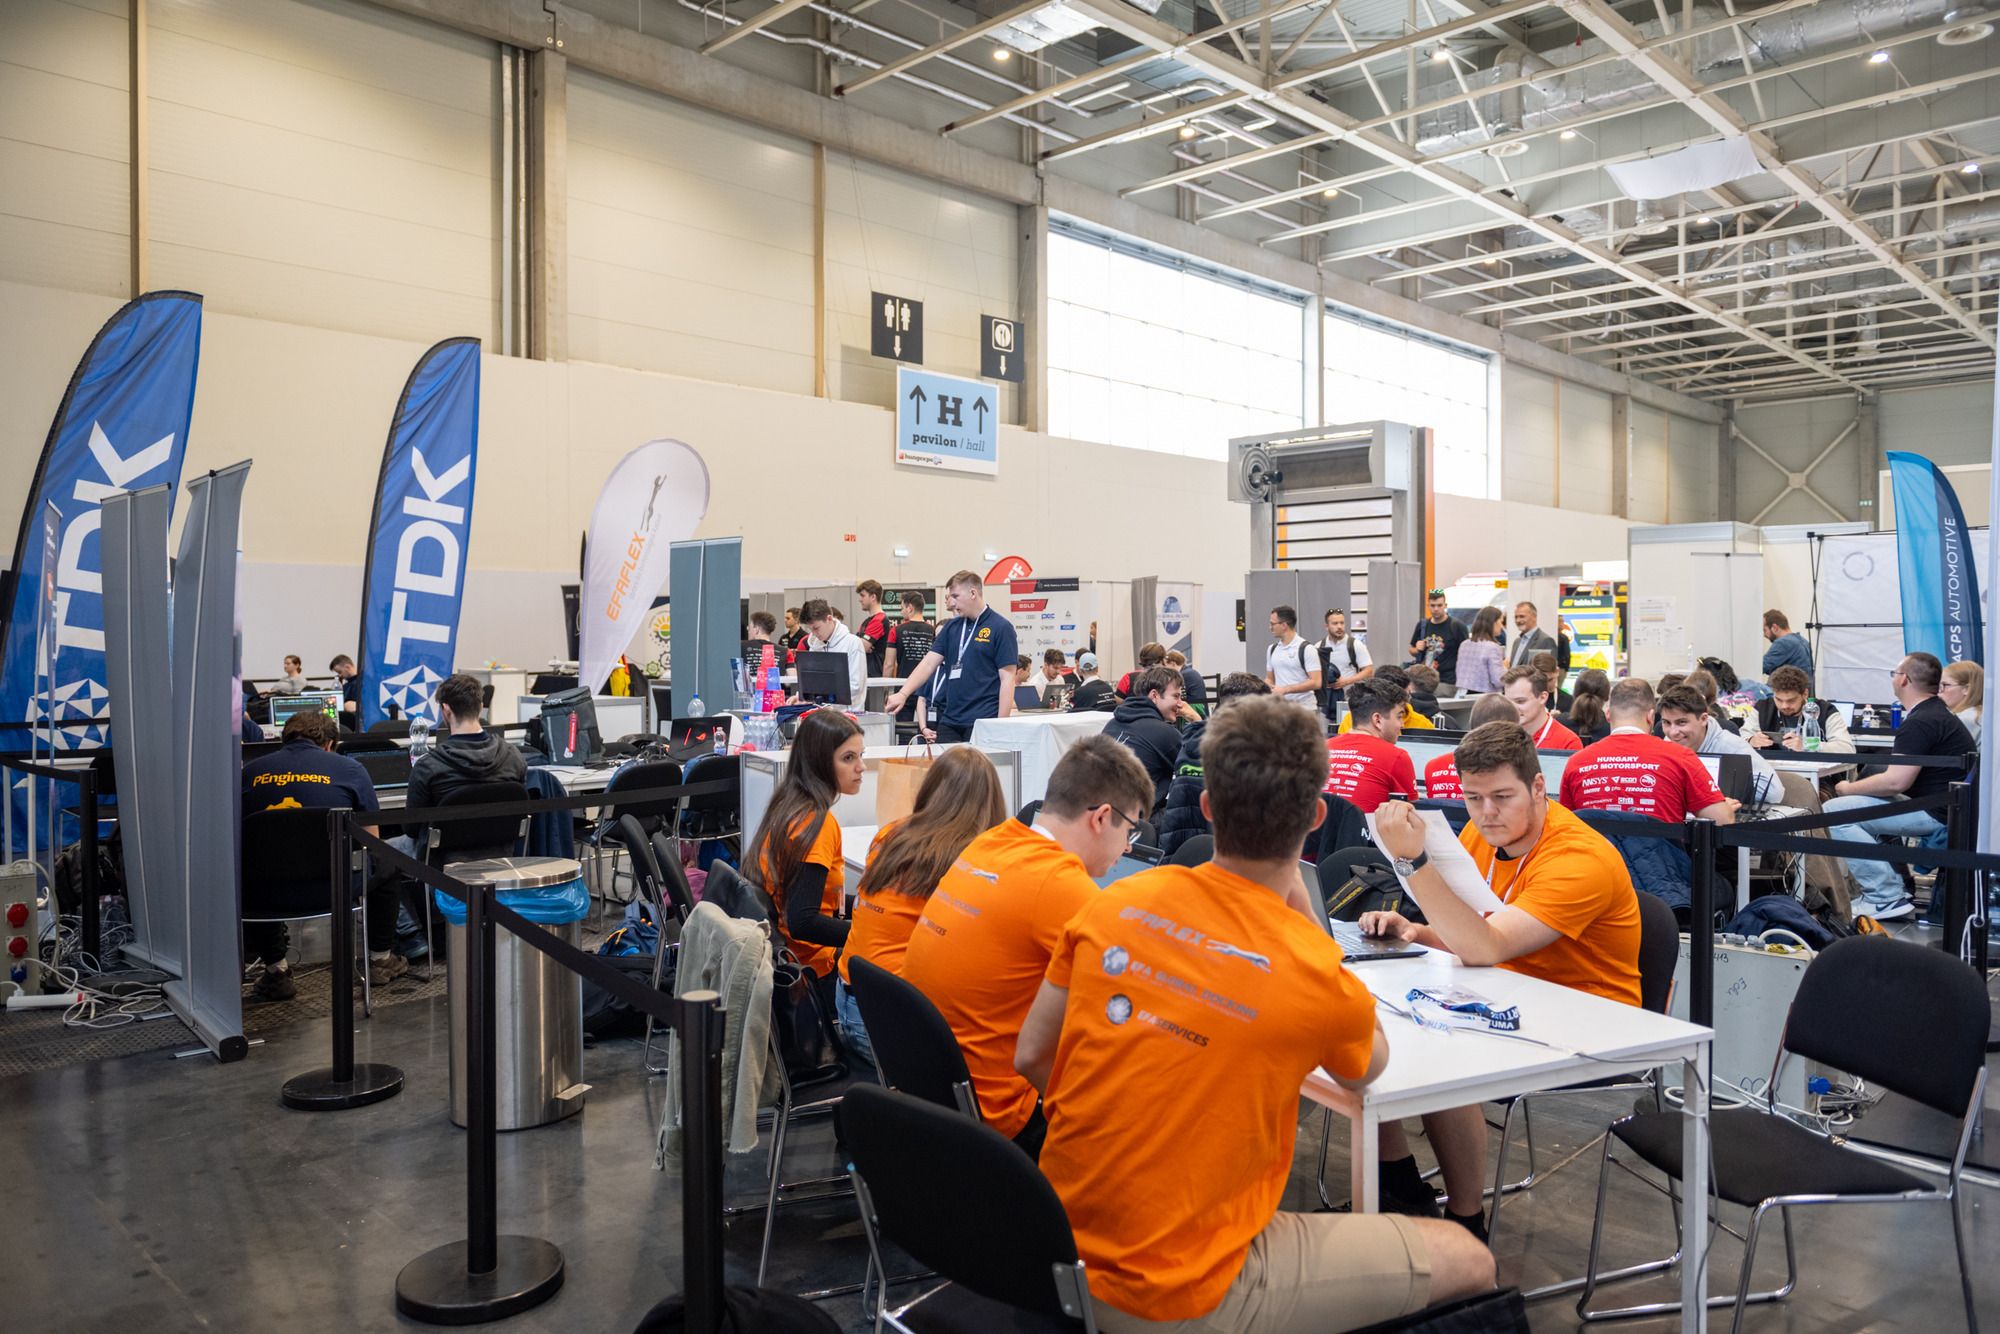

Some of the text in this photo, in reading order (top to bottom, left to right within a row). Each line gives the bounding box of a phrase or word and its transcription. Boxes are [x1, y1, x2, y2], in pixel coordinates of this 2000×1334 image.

[937, 393, 963, 427] H
[912, 433, 957, 448] pavilon
[966, 438, 985, 452] hall
[384, 445, 471, 666] TDK
[1944, 517, 1961, 622] AUTOMOTIVE
[606, 531, 646, 622] EFAFLEX
[1950, 625, 1962, 664] ACPS
[1579, 763, 1599, 774] KEFO
[1582, 776, 1609, 788] ANSYS
[1201, 988, 1259, 1020] DOCKING
[1136, 1009, 1210, 1048] EFASERVICES
